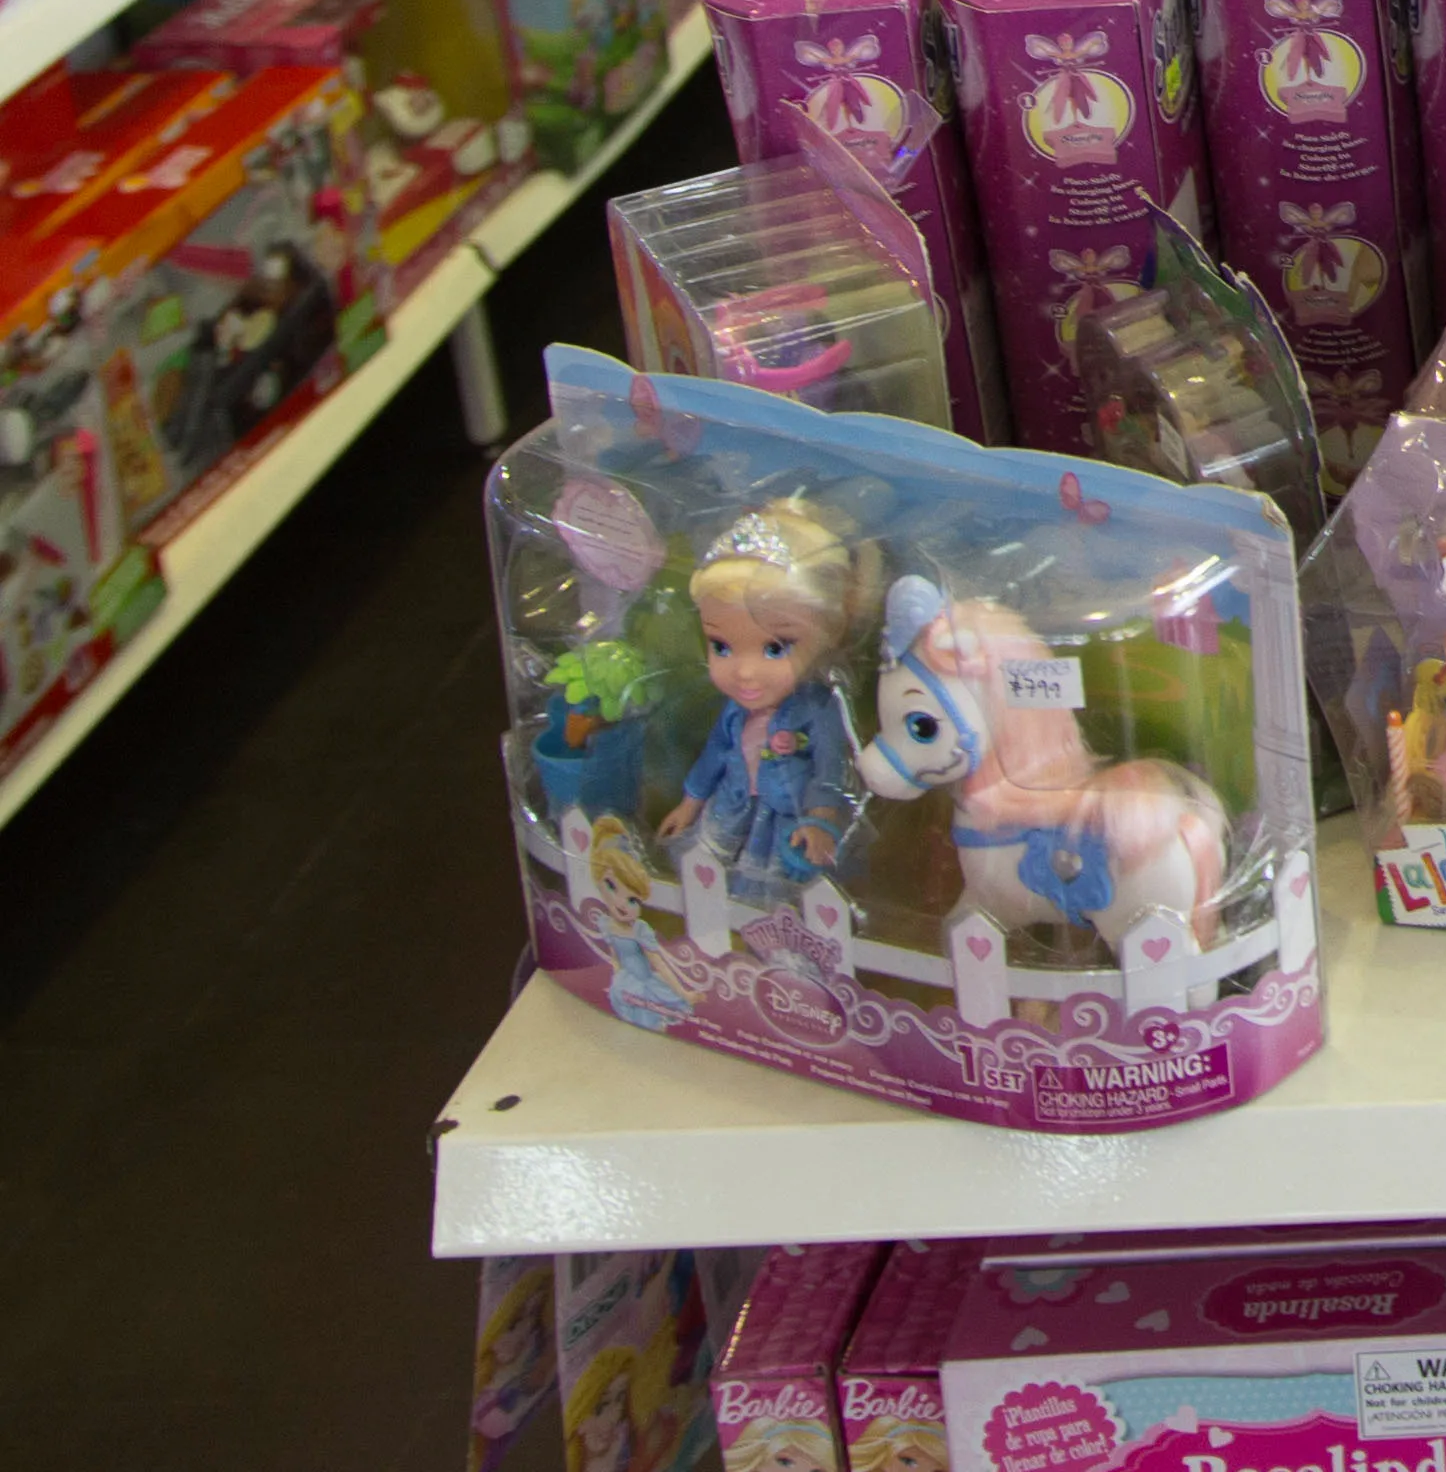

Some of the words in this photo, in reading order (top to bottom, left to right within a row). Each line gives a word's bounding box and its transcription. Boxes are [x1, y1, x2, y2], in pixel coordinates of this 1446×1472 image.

[783, 916, 845, 974] first
[956, 1041, 978, 1085] 1
[984, 1065, 1025, 1093] SET
[1083, 1054, 1211, 1090] WARNING:
[1038, 1090, 1104, 1109] CHOKING
[1107, 1085, 1169, 1107] HAZARD
[1242, 1293, 1399, 1324] Rosalinda
[716, 1379, 826, 1425] Barbie
[841, 1377, 945, 1422] Barbie
[1363, 1380, 1425, 1395] CHOKING
[1365, 1398, 1385, 1409] Not
[1390, 1396, 1407, 1408] for
[1004, 1432, 1023, 1451] de
[1026, 1427, 1058, 1448] ropa
[1059, 1419, 1092, 1443] para
[1003, 1452, 1047, 1472] llenar
[1050, 1446, 1067, 1464] de
